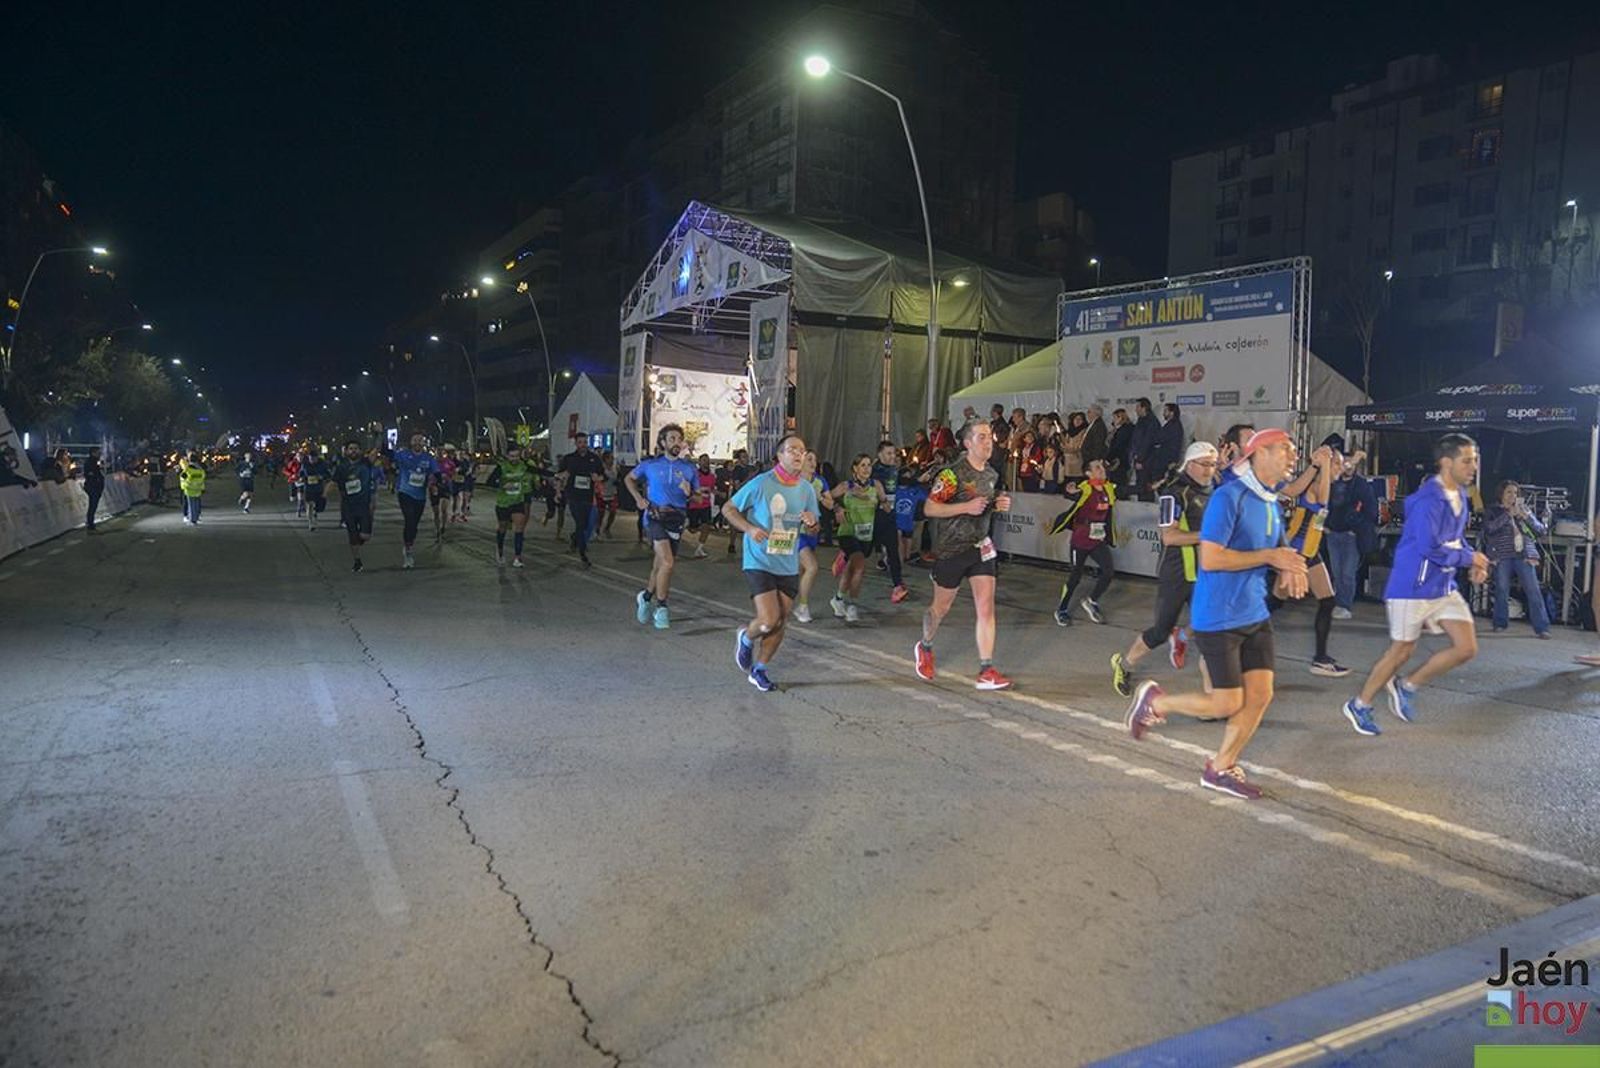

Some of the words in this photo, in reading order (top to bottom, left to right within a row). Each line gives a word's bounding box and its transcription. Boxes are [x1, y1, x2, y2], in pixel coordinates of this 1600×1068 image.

[1127, 301, 1153, 326] SAN
[1157, 291, 1203, 323] ANTÓN
[1076, 310, 1089, 331] 41
[1225, 335, 1269, 352] calderón
[1425, 409, 1487, 421] superscreen
[1507, 406, 1577, 420] superscreen
